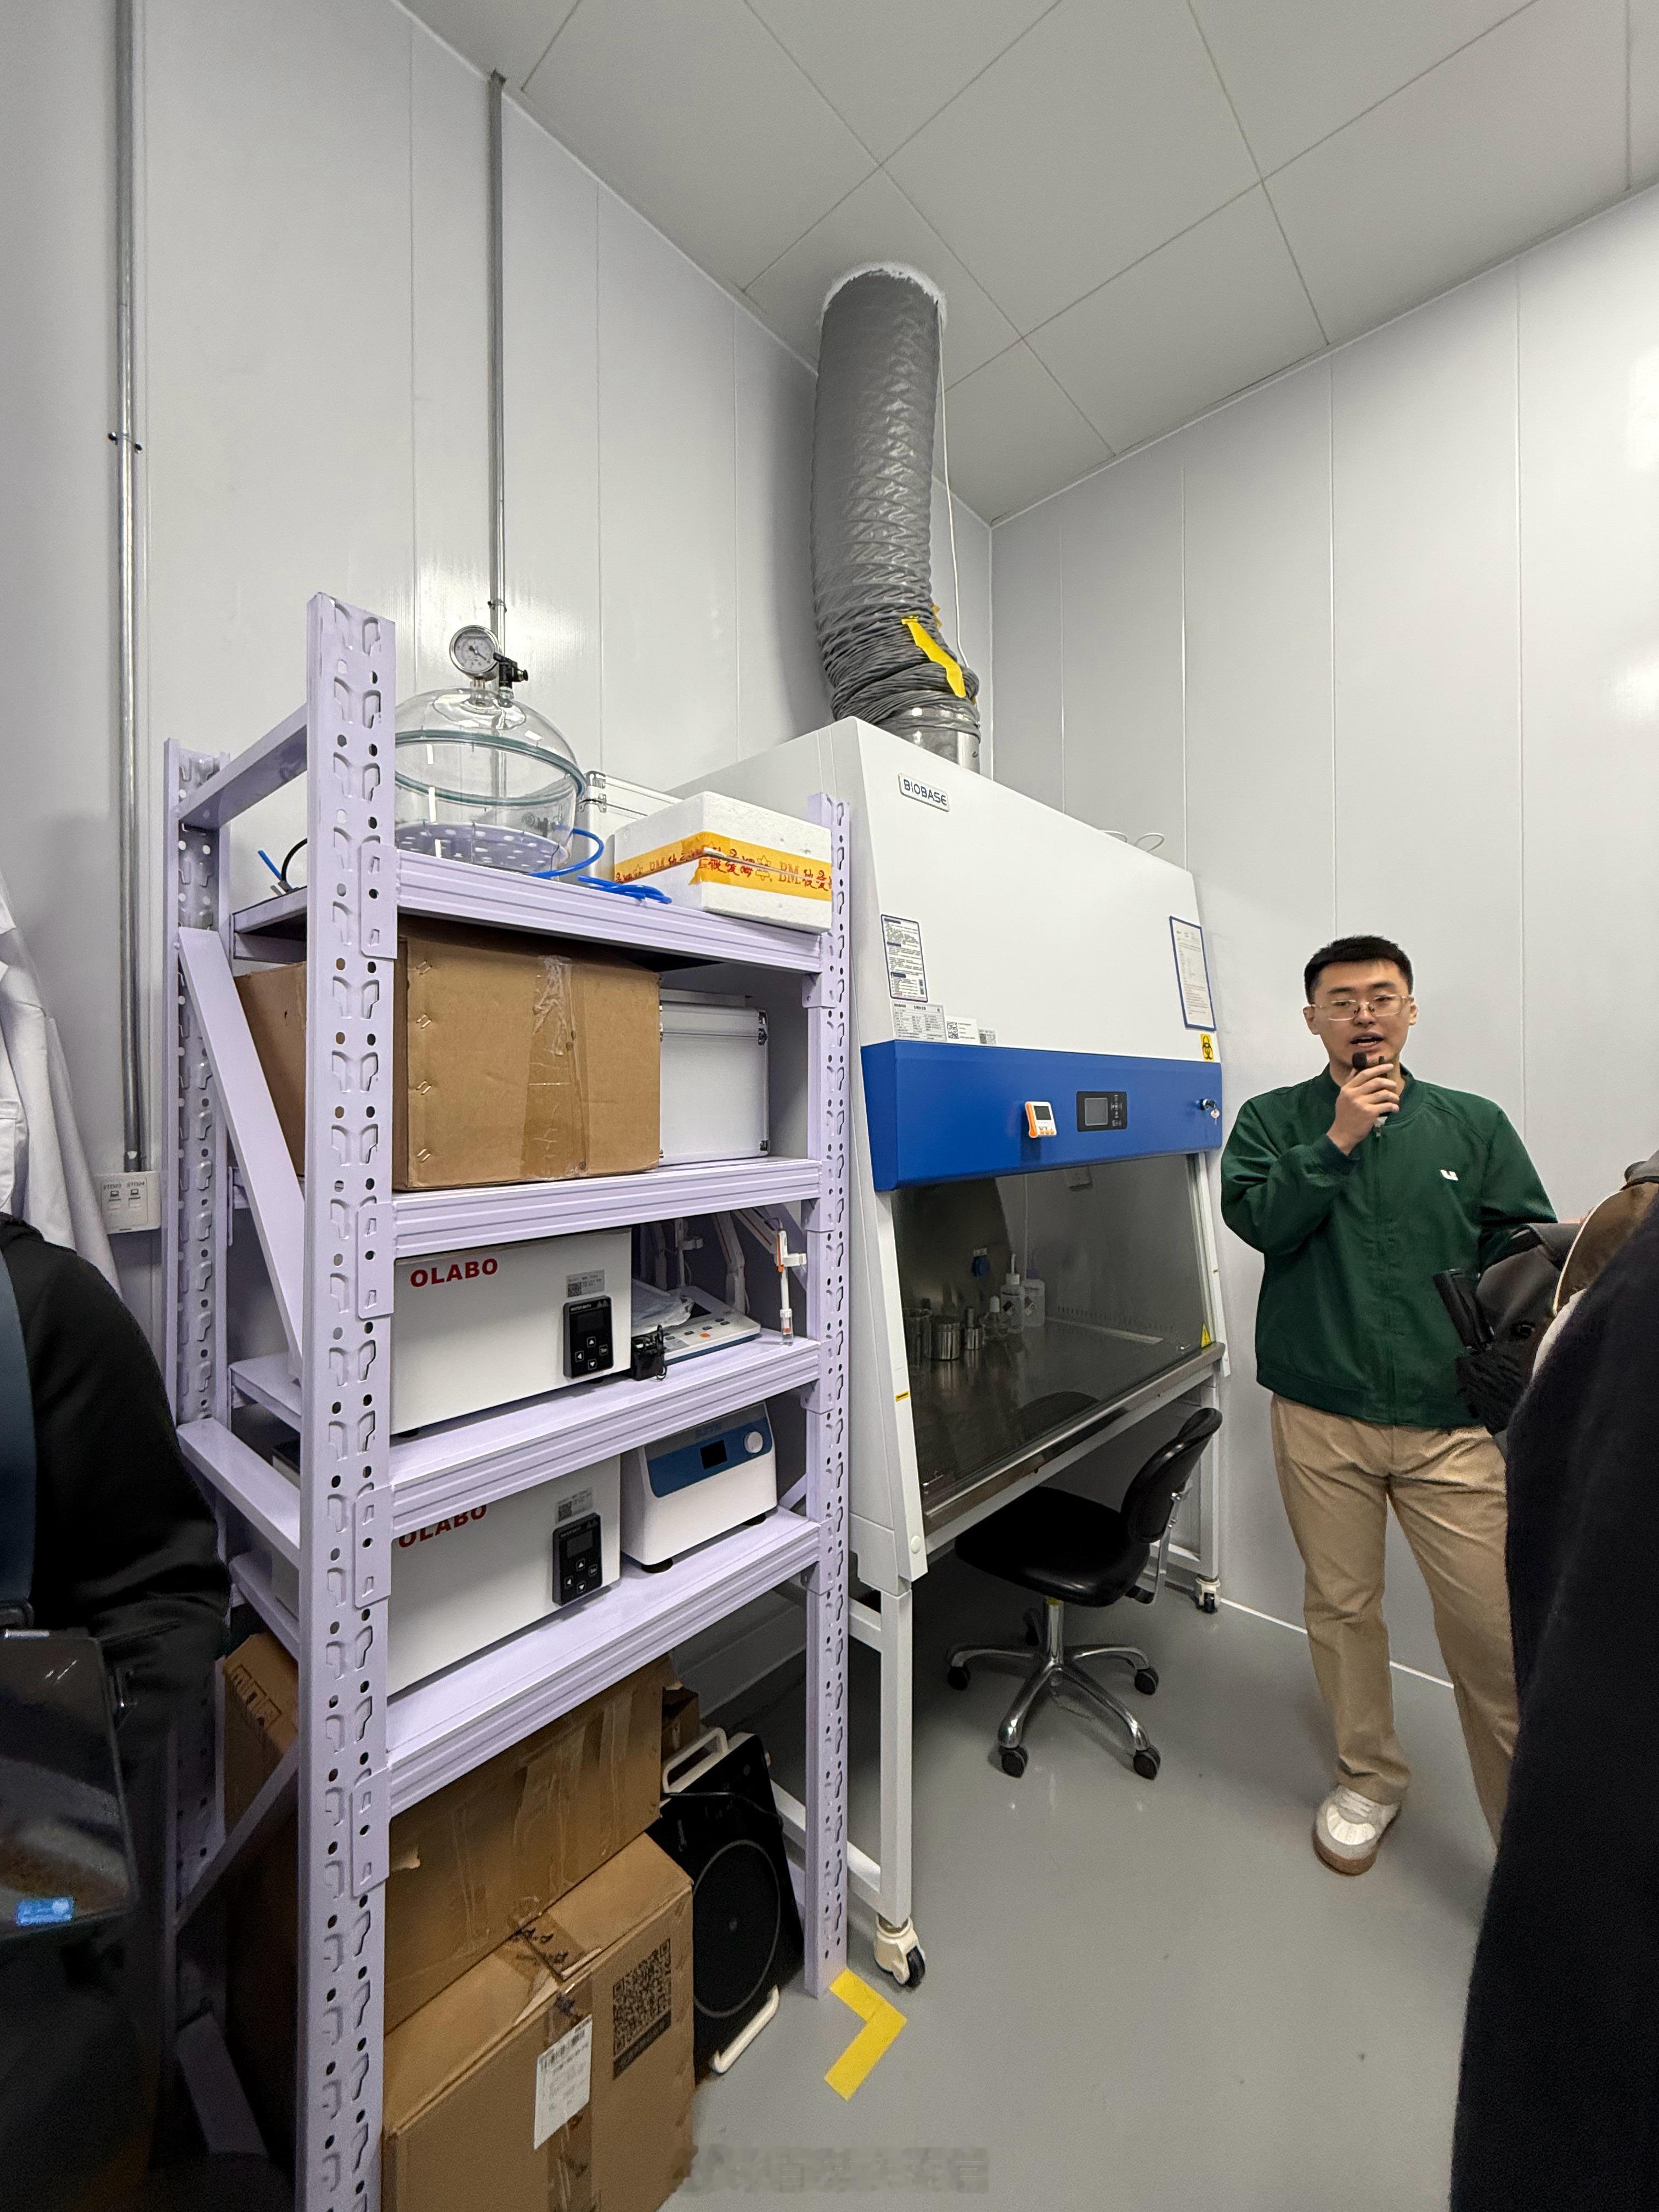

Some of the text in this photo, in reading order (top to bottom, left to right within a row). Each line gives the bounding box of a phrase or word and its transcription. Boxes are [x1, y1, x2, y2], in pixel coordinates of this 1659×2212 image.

[904, 778, 947, 806] BIOBASE
[410, 1258, 498, 1288] OLABO
[399, 1504, 487, 1548] OLABO
